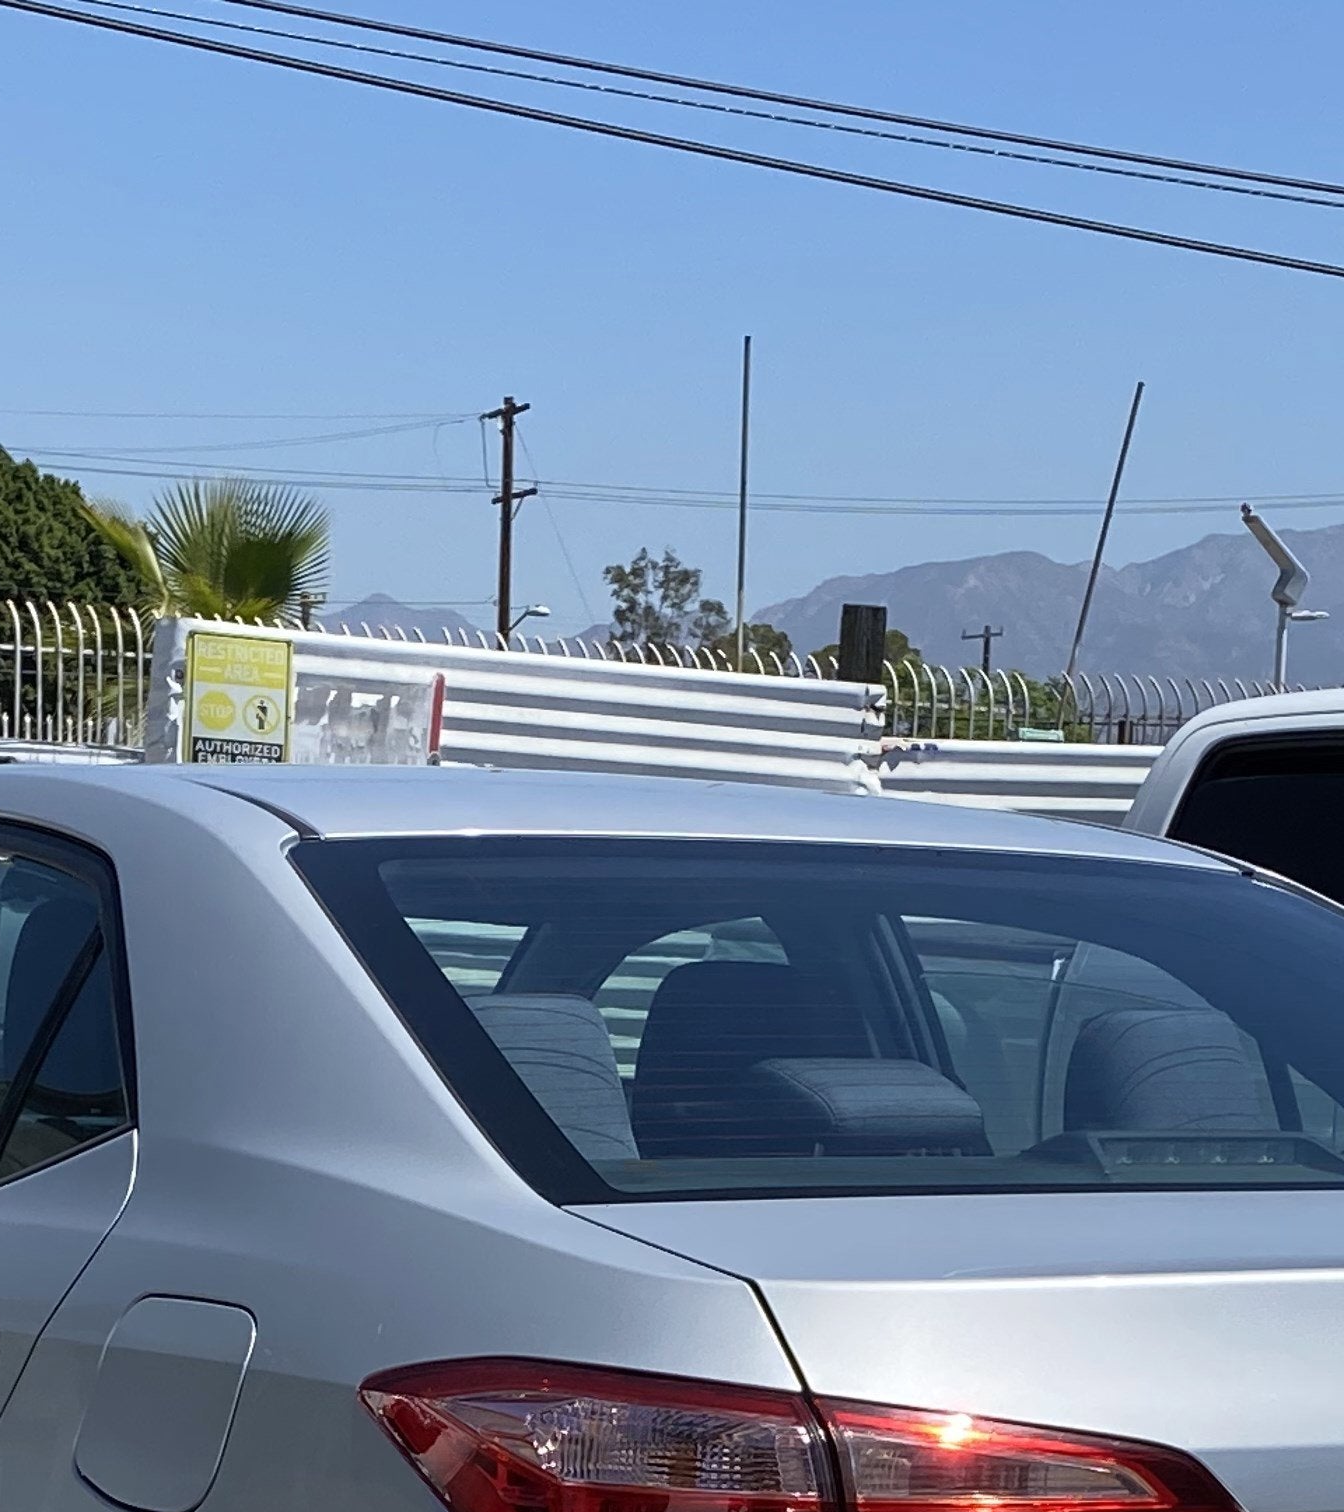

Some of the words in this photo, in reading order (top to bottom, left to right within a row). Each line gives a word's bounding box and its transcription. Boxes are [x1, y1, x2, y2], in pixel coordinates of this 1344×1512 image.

[197, 641, 284, 664] RESTRICTED
[223, 664, 260, 681] AREA
[199, 703, 233, 717] STOP
[196, 739, 281, 758] AUTHORIZED
